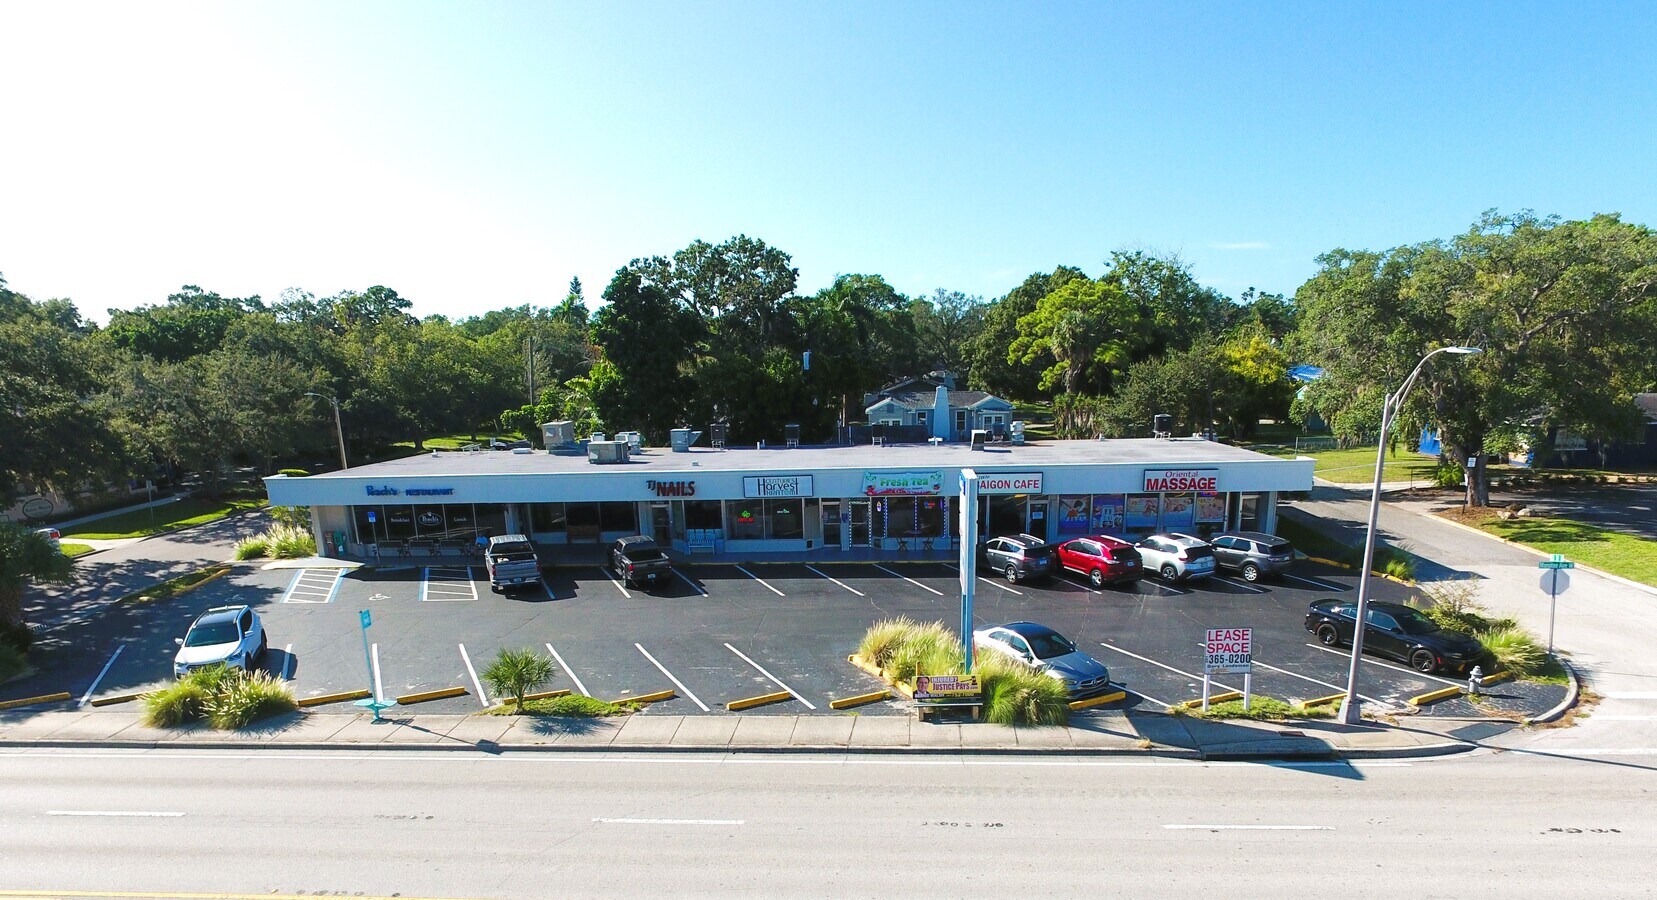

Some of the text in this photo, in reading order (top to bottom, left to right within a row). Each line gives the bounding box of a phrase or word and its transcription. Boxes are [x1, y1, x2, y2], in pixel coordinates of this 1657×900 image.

[757, 477, 800, 496] Harvest
[880, 477, 929, 487] Fresh Tea
[979, 479, 1040, 489] AIGON CAFE
[1146, 477, 1217, 491] MASSAGE
[405, 487, 455, 497] RESTAURANT
[646, 480, 695, 497] TJ NAILS
[1207, 629, 1250, 641] LEASE
[1206, 642, 1250, 653] SPACE
[1208, 653, 1251, 664] 365-0200
[932, 682, 955, 691] JUSTICE
[955, 682, 970, 690] PAYS
